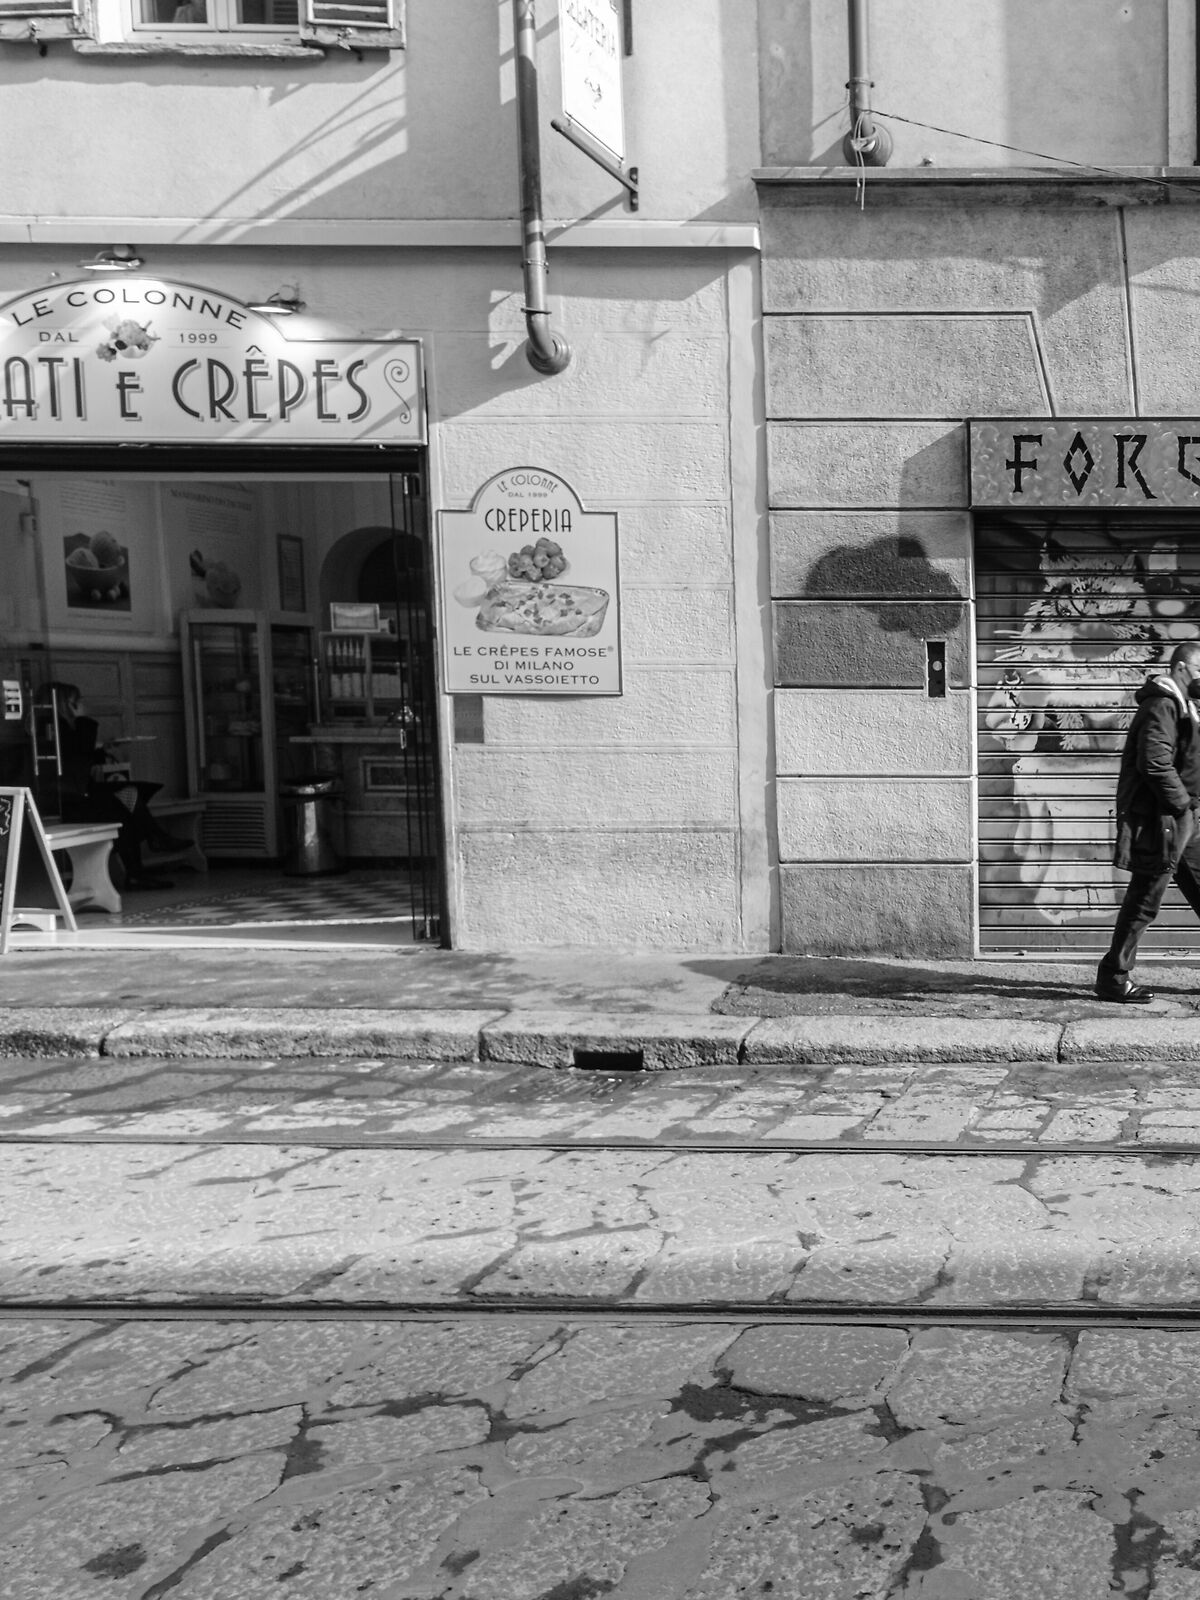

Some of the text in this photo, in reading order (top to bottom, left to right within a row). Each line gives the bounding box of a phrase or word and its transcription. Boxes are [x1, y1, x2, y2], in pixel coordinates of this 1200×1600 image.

[11, 287, 249, 331] LE COLONNE
[38, 331, 218, 344] DAL 1999
[115, 371, 143, 421] E
[172, 344, 370, 423] CRÊPES
[496, 474, 559, 493] LE COLONNE
[484, 508, 572, 533] CREPERIA
[453, 646, 471, 656] LE
[477, 644, 539, 657] CRÊPES
[494, 660, 574, 671] DI MILANO
[469, 674, 600, 685] SUL VASSOIETTO
